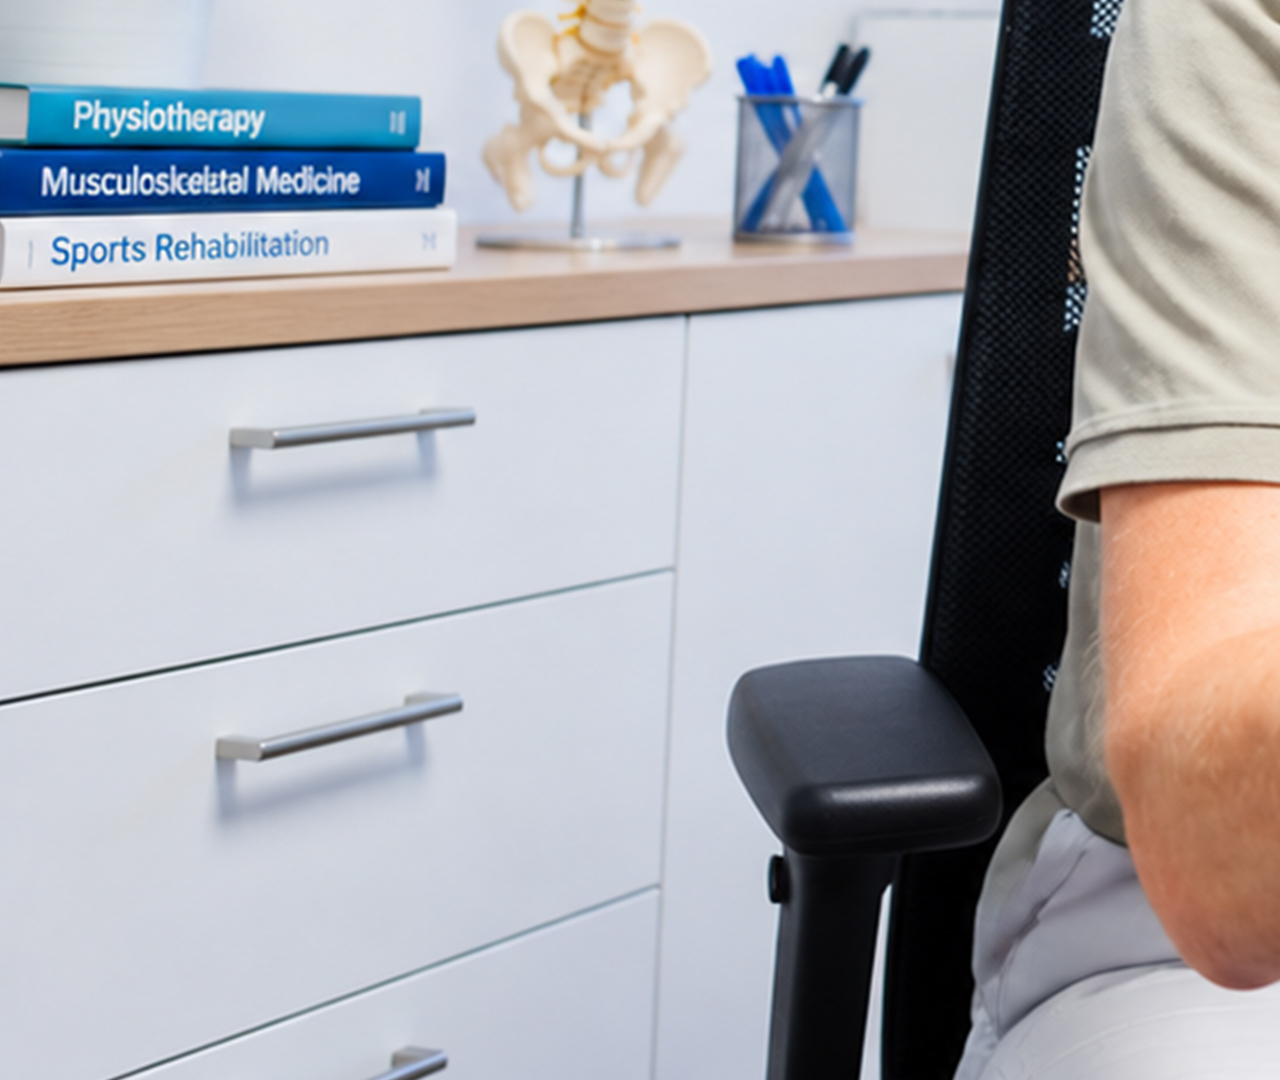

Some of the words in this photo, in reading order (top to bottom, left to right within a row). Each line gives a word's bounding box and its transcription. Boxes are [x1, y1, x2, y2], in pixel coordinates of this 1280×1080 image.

[73, 100, 266, 138] Physiotherapy
[256, 165, 361, 194] Medicine
[51, 235, 146, 272] Sports
[155, 230, 329, 261] Rehabilitation
